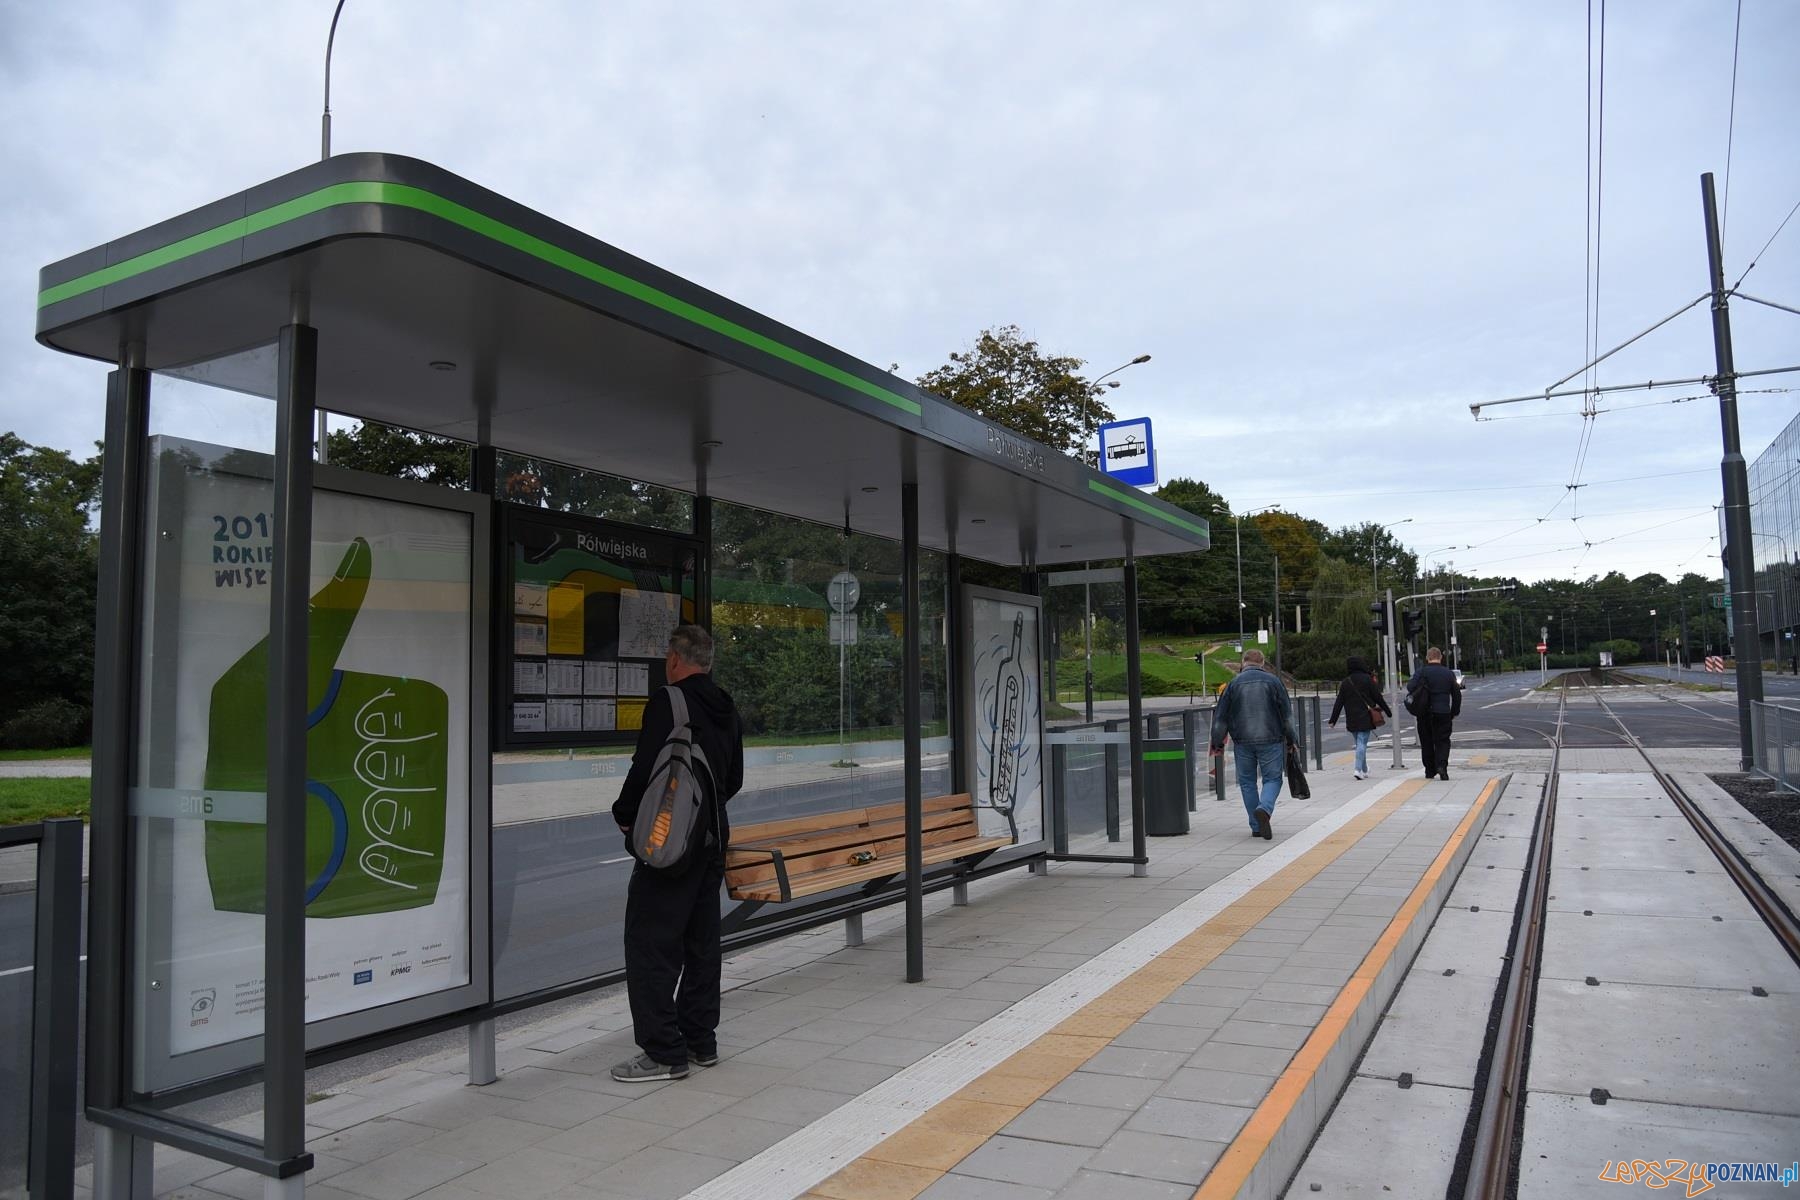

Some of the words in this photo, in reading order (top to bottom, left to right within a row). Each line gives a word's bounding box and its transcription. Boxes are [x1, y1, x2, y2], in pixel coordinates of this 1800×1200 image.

[213, 512, 273, 542] 201
[576, 532, 648, 560] Półwiejska
[390, 965, 412, 977] KPMG
